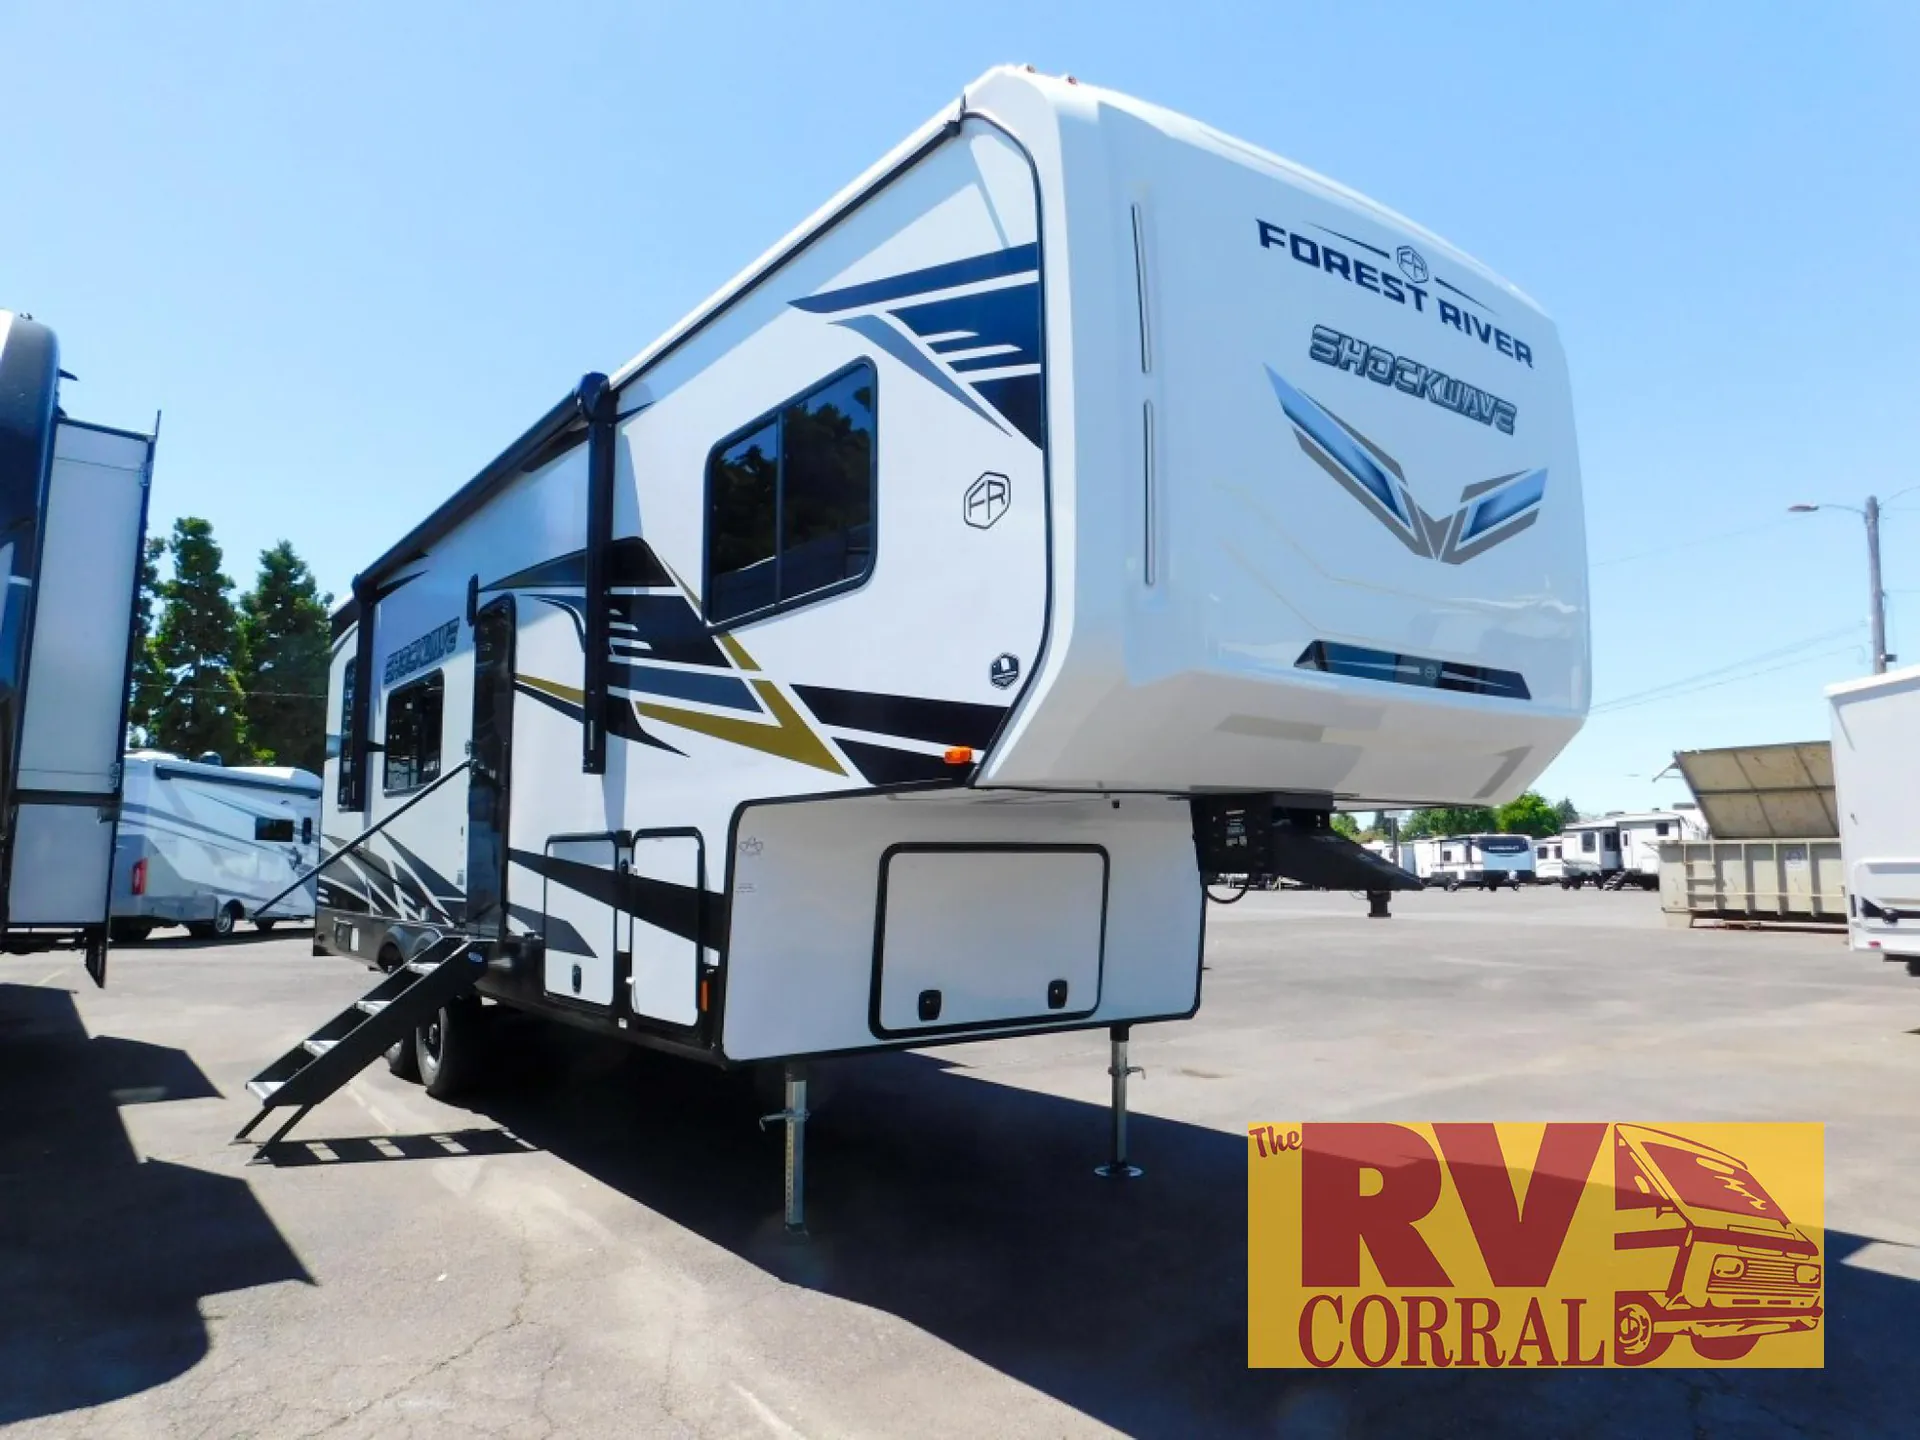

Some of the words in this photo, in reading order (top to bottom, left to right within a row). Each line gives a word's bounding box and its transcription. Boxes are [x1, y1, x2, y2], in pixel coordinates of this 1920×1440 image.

[1256, 218, 1428, 312] FOREST
[1437, 298, 1534, 369] RIVER
[1309, 324, 1518, 436] SHOCKWAVE
